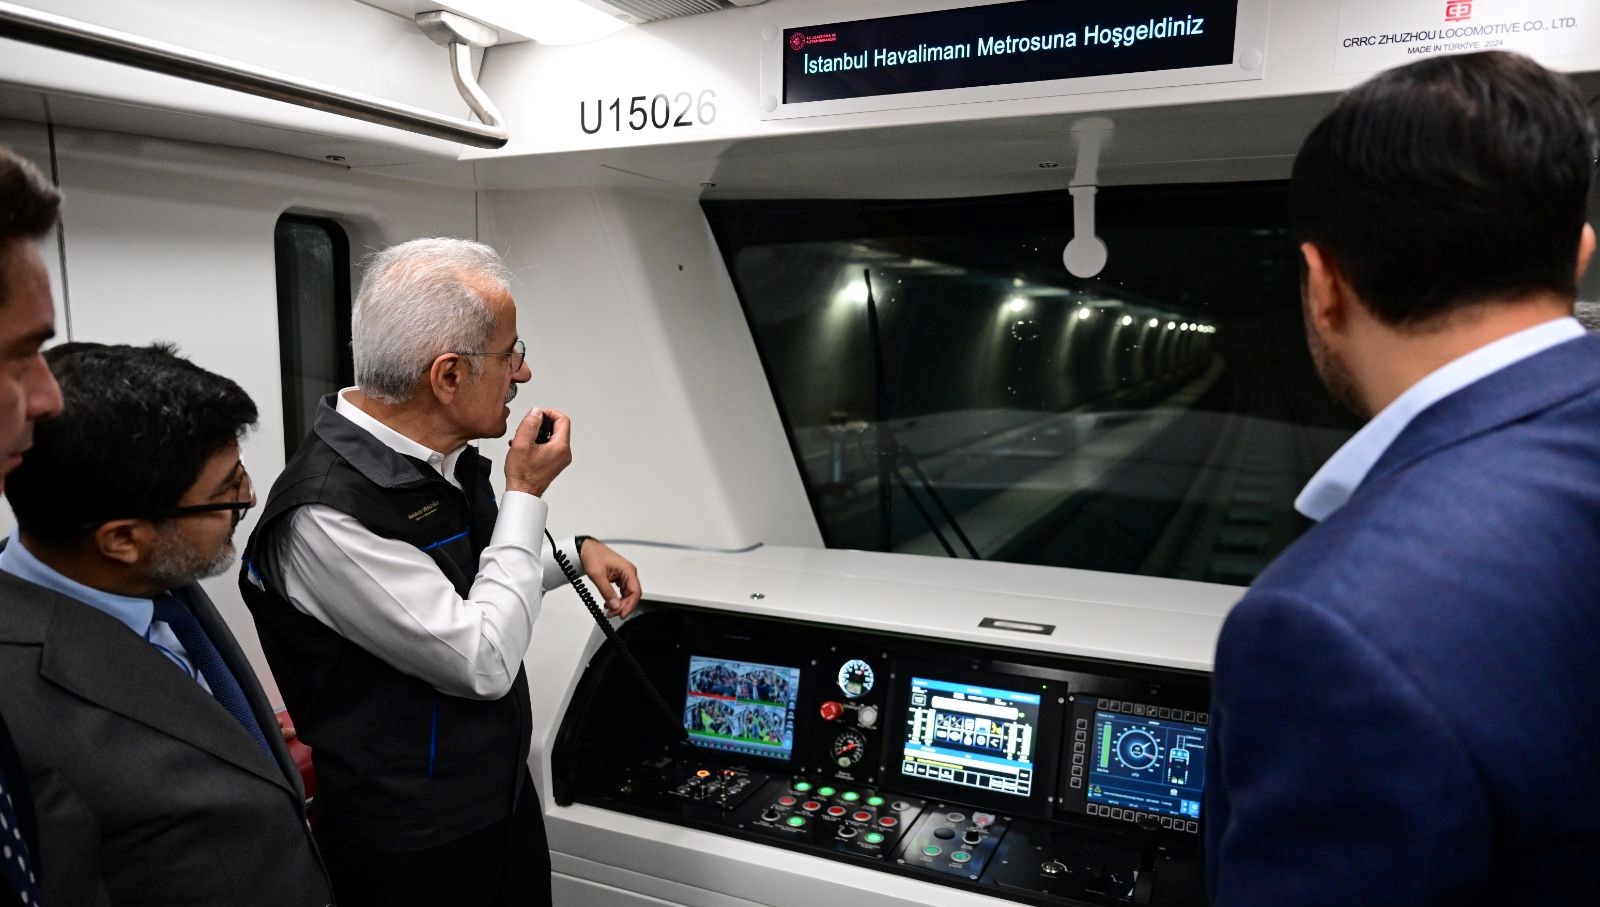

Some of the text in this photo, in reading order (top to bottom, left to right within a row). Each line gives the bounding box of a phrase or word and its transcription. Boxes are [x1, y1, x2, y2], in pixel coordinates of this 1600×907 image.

[874, 43, 971, 68] Havalimanı
[977, 32, 1077, 57] Metrosuna
[1083, 15, 1204, 48] Hoşgeldiniz
[1343, 35, 1376, 48] CRRC
[1378, 30, 1436, 45] ZHUZHOU
[1438, 22, 1521, 39] LOCOMOTIVE
[1551, 17, 1579, 29] LTD.
[1407, 46, 1432, 54] MADE
[1484, 39, 1504, 48] 2024
[580, 89, 717, 135] U15026
